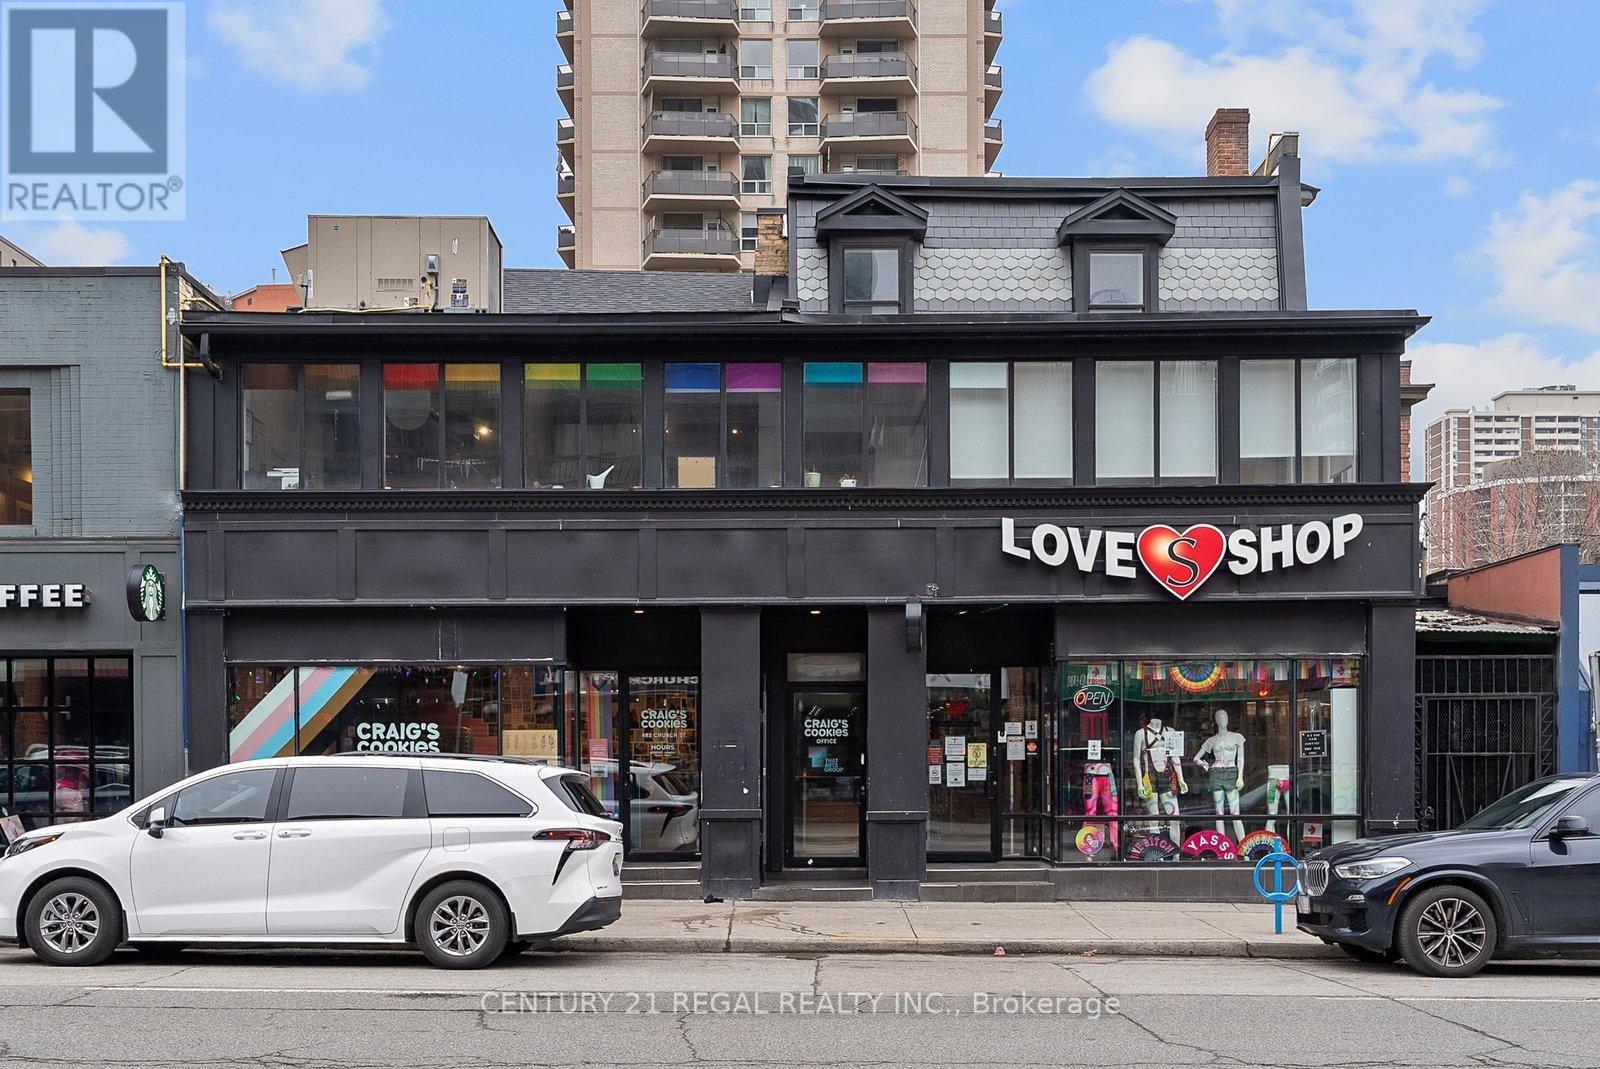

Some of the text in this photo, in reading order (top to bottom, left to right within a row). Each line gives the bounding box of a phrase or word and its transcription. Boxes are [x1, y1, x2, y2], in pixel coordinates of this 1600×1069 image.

[1001, 516, 1137, 579] LOVE
[1227, 513, 1364, 576] SHOP
[0, 584, 83, 607] FFEE
[1076, 691, 1111, 706] OPEN
[641, 709, 688, 720] CRAIG'S
[356, 722, 440, 740] CRAIG'S
[804, 719, 849, 729] CRAIG'S
[1187, 834, 1235, 860] YASSS
